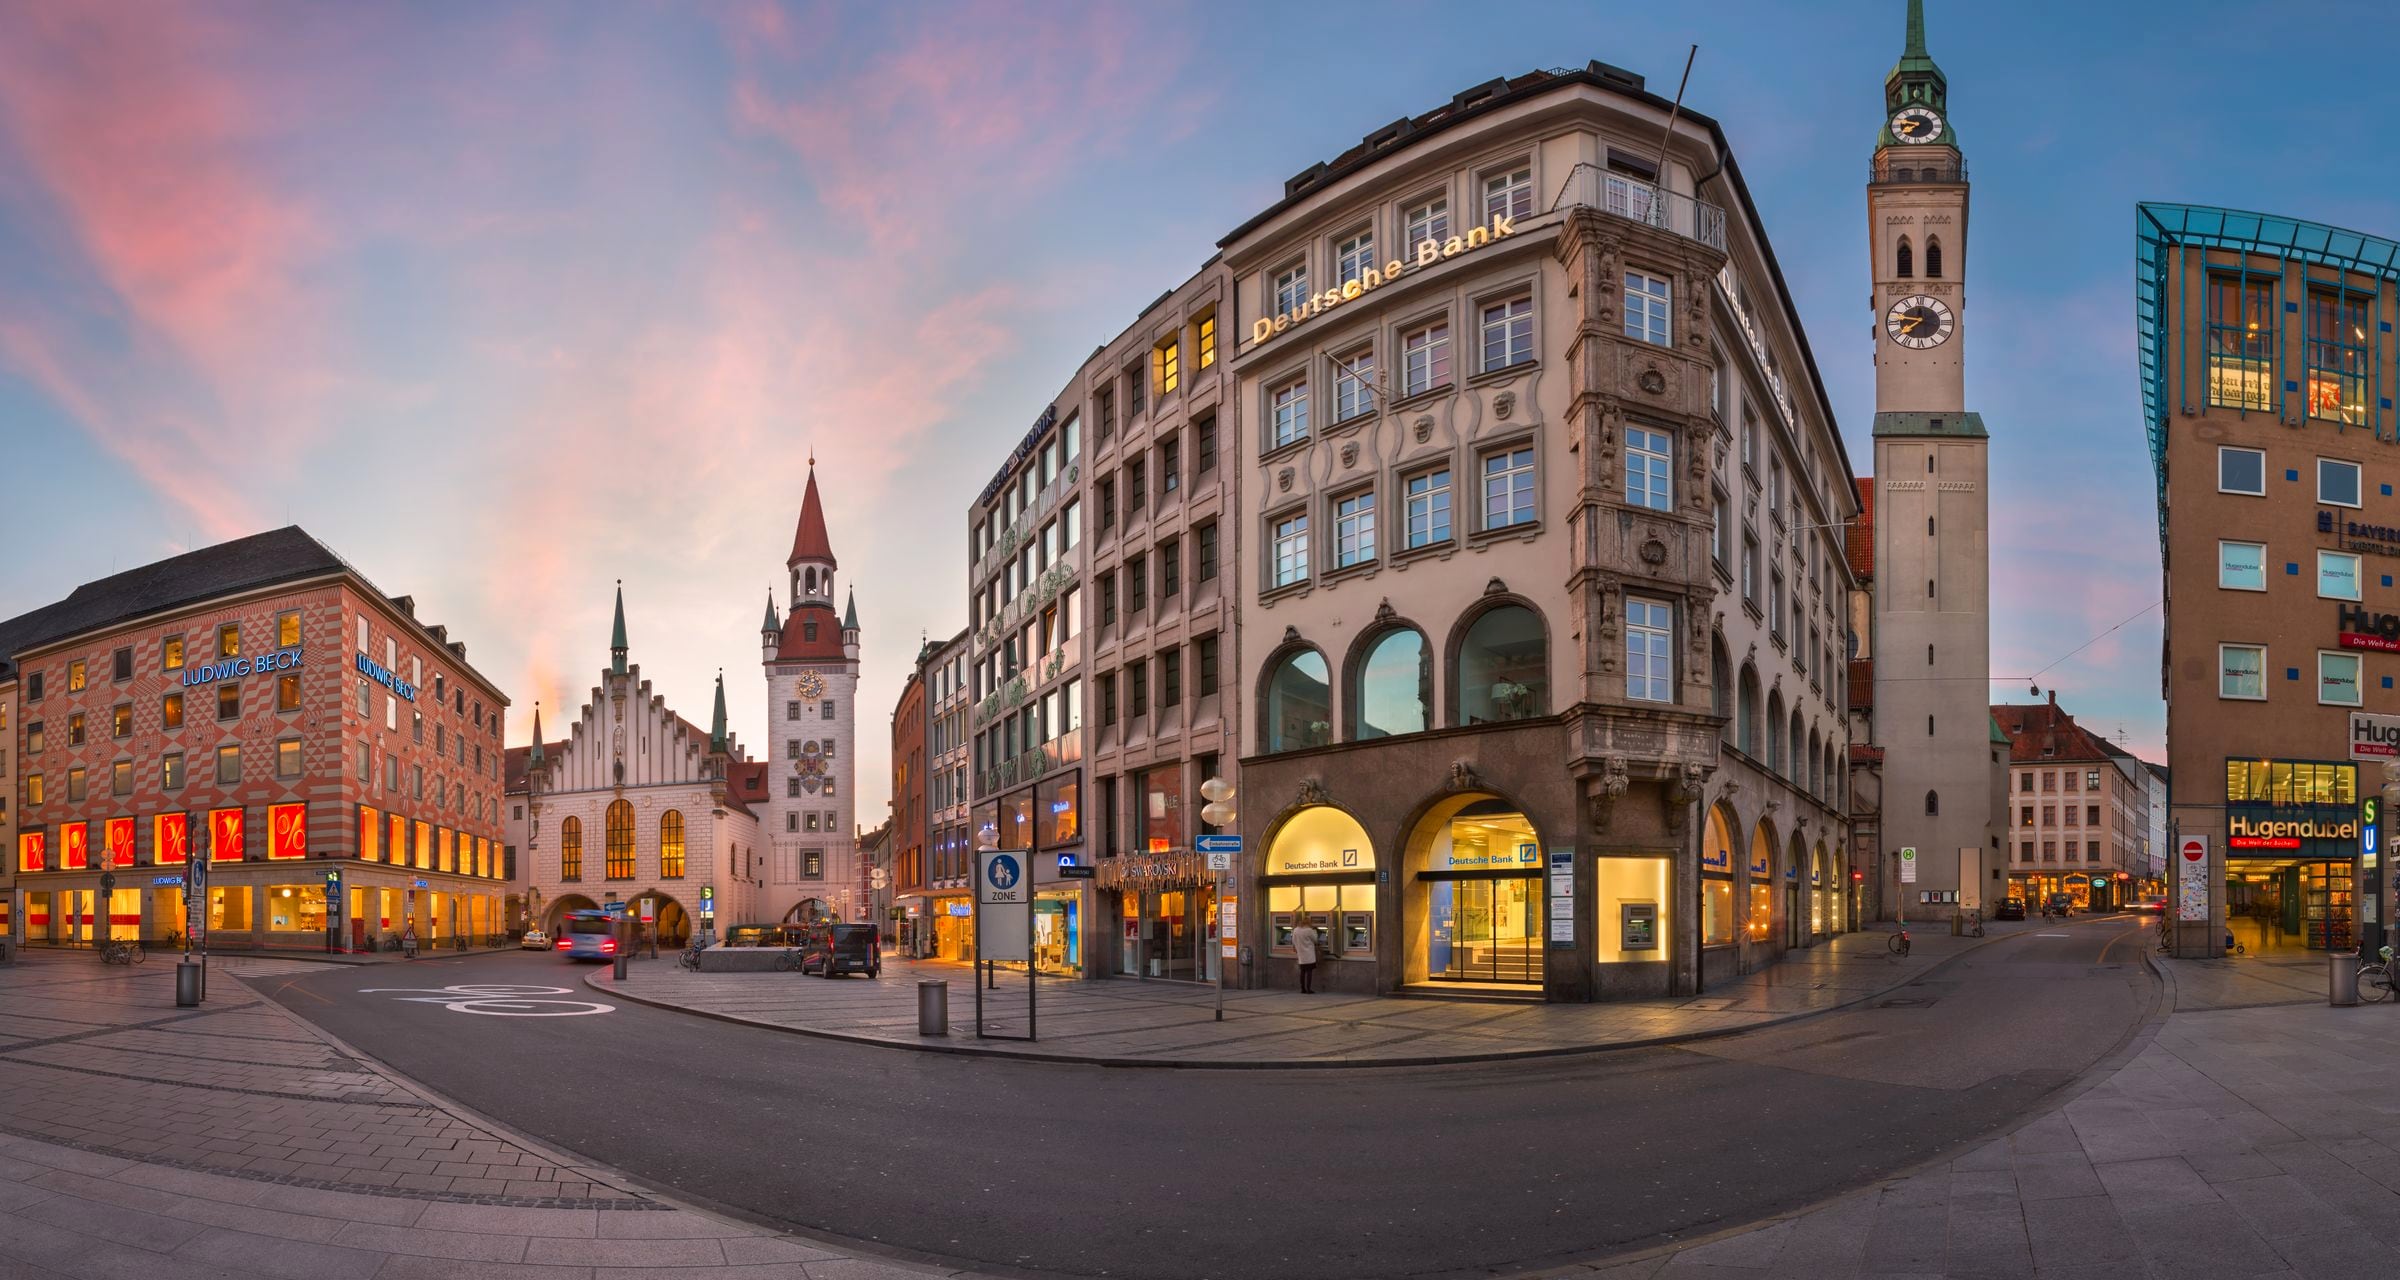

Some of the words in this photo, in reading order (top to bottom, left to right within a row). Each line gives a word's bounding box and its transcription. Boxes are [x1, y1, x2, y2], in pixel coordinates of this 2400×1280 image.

[1253, 259, 1405, 346] Deutsche
[1418, 213, 1517, 268] Bank
[1722, 266, 1773, 383] Deutsche
[1774, 375, 1795, 433] Bank
[2339, 603, 2400, 640] Hug
[2353, 637, 2366, 646] Die
[2368, 639, 2384, 648] Welt
[2385, 641, 2398, 649] der
[183, 658, 250, 686] LUDWIG
[255, 649, 304, 673] BECK
[356, 653, 393, 689] LUDWIG
[394, 676, 417, 702] BECK
[2360, 745, 2372, 753] Die
[2372, 745, 2387, 753] Welt
[2365, 800, 2375, 824] S
[2230, 815, 2358, 840] Hugendubel
[2365, 828, 2374, 851] U
[1131, 862, 1177, 877] SWAROVSKI
[1284, 861, 1318, 870] Deutsche
[1319, 860, 1338, 868] Bank
[1448, 856, 1489, 865] Deutsche
[1491, 855, 1513, 864] Bank
[153, 877, 176, 885] LUDWIG
[704, 888, 712, 899] S
[992, 891, 1016, 901] ZONE
